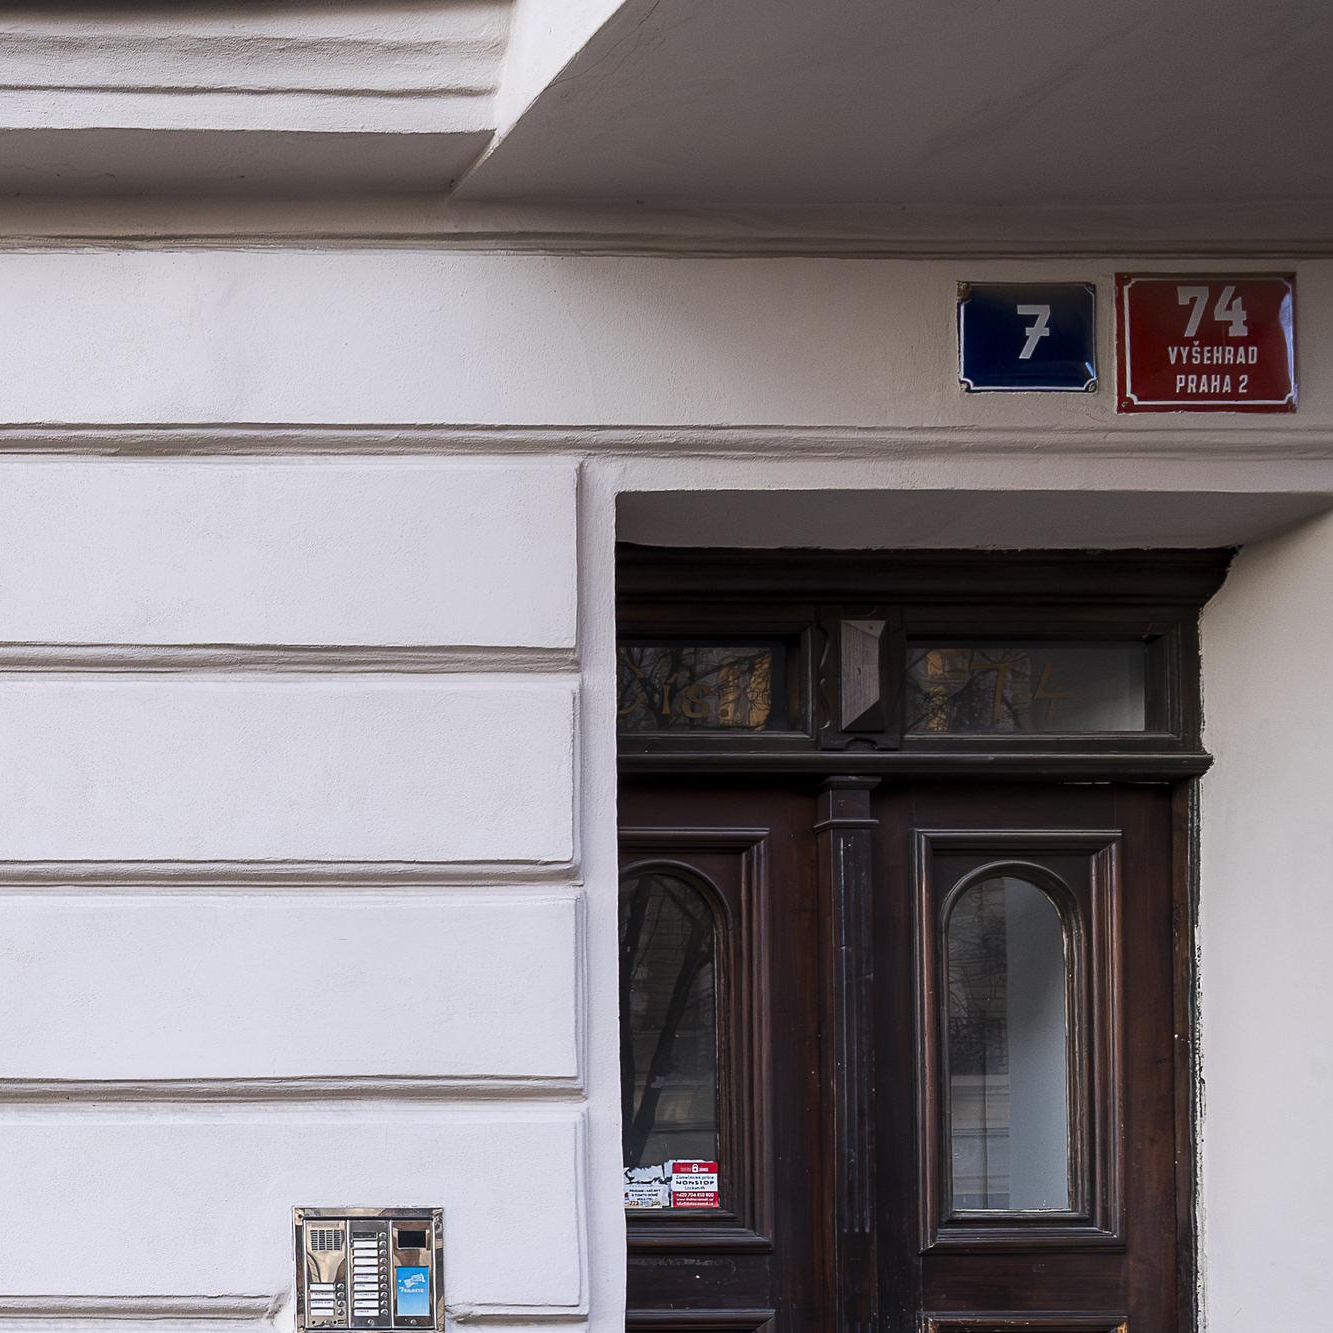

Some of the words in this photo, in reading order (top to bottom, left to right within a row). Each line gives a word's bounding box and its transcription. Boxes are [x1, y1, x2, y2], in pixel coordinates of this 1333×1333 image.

[1176, 285, 1248, 337] 74
[1016, 304, 1051, 360] 7
[1167, 340, 1258, 366] VYŠEHRAD
[1175, 373, 1231, 393] PRAHA
[1238, 373, 1248, 393] 2
